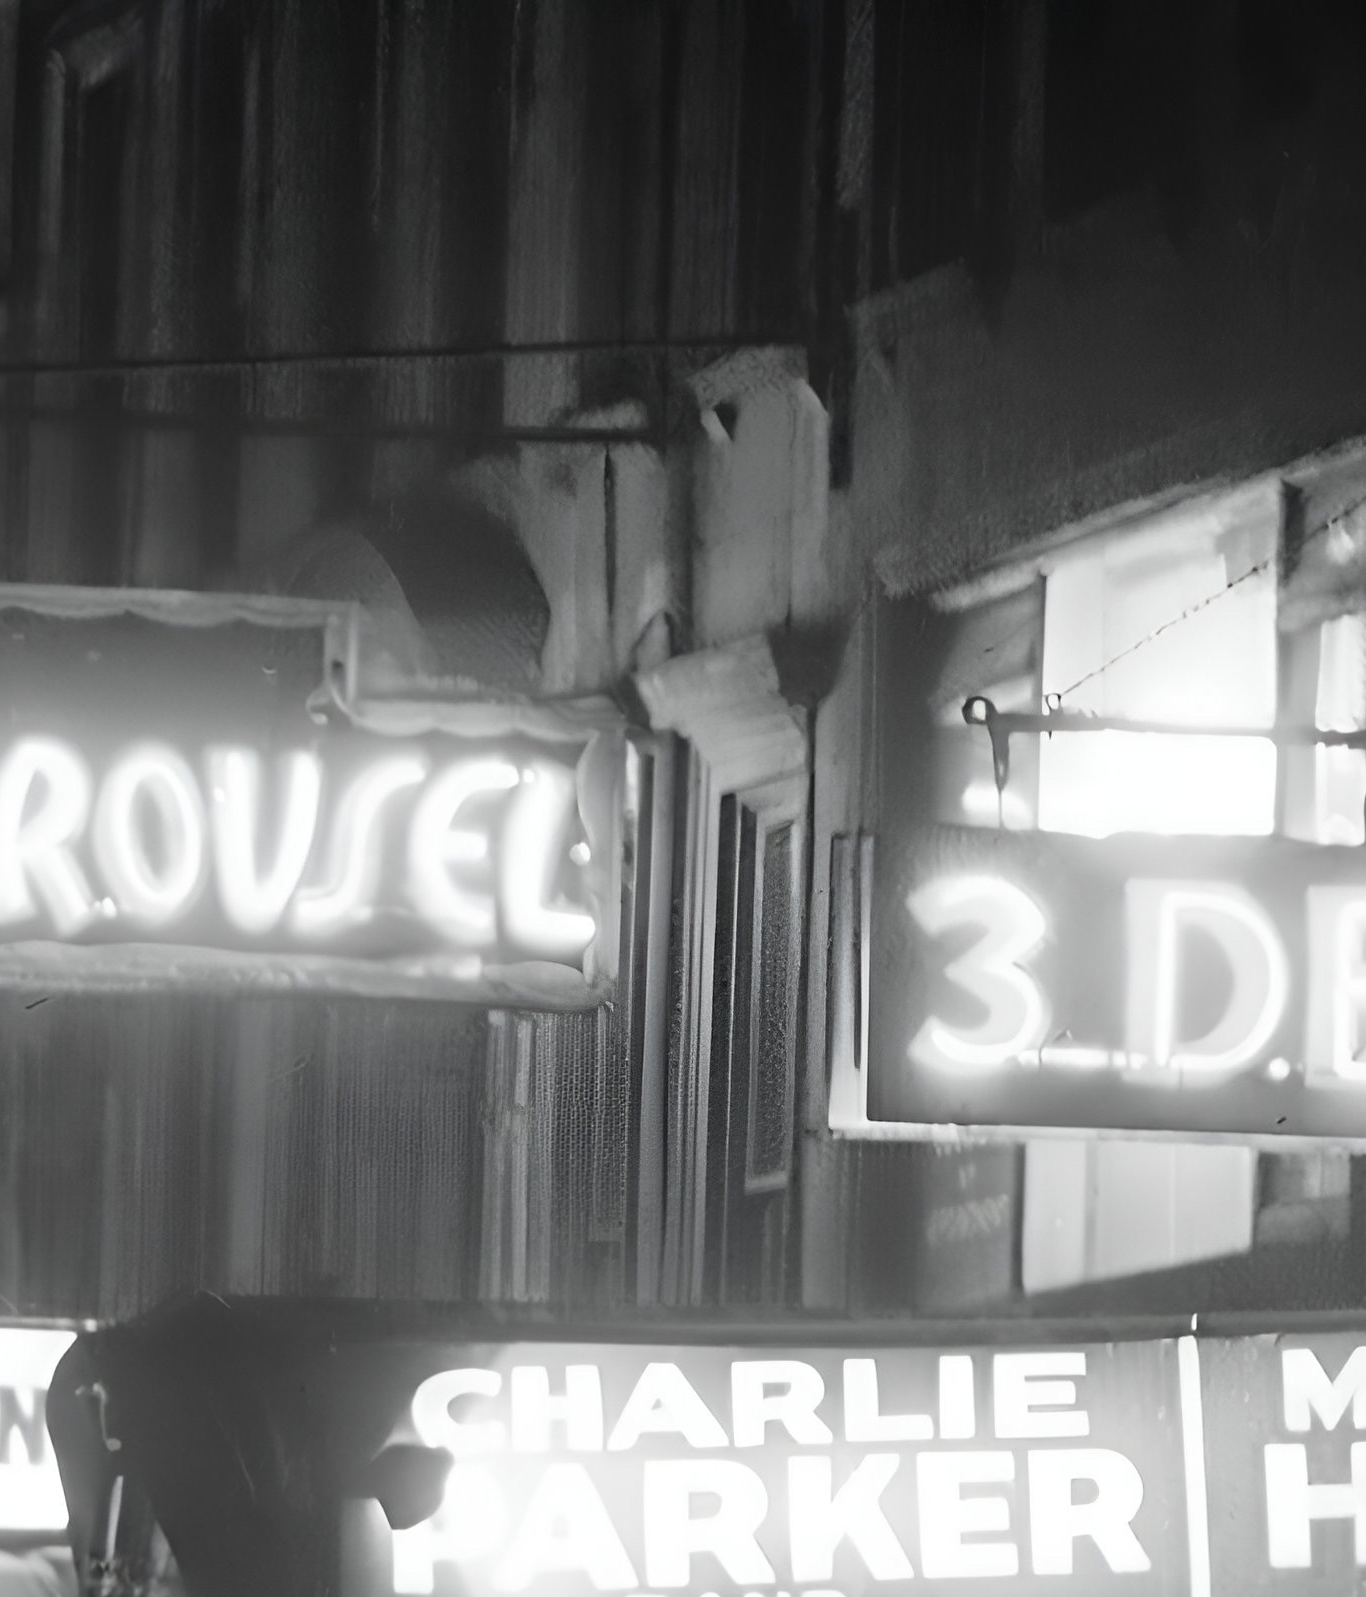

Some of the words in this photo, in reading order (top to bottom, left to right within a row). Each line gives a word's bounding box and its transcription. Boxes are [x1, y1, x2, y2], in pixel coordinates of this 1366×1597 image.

[906, 874, 1051, 1077] 3
[411, 1350, 1090, 1453] CHARLIE
[391, 1446, 1151, 1594] PARKER
